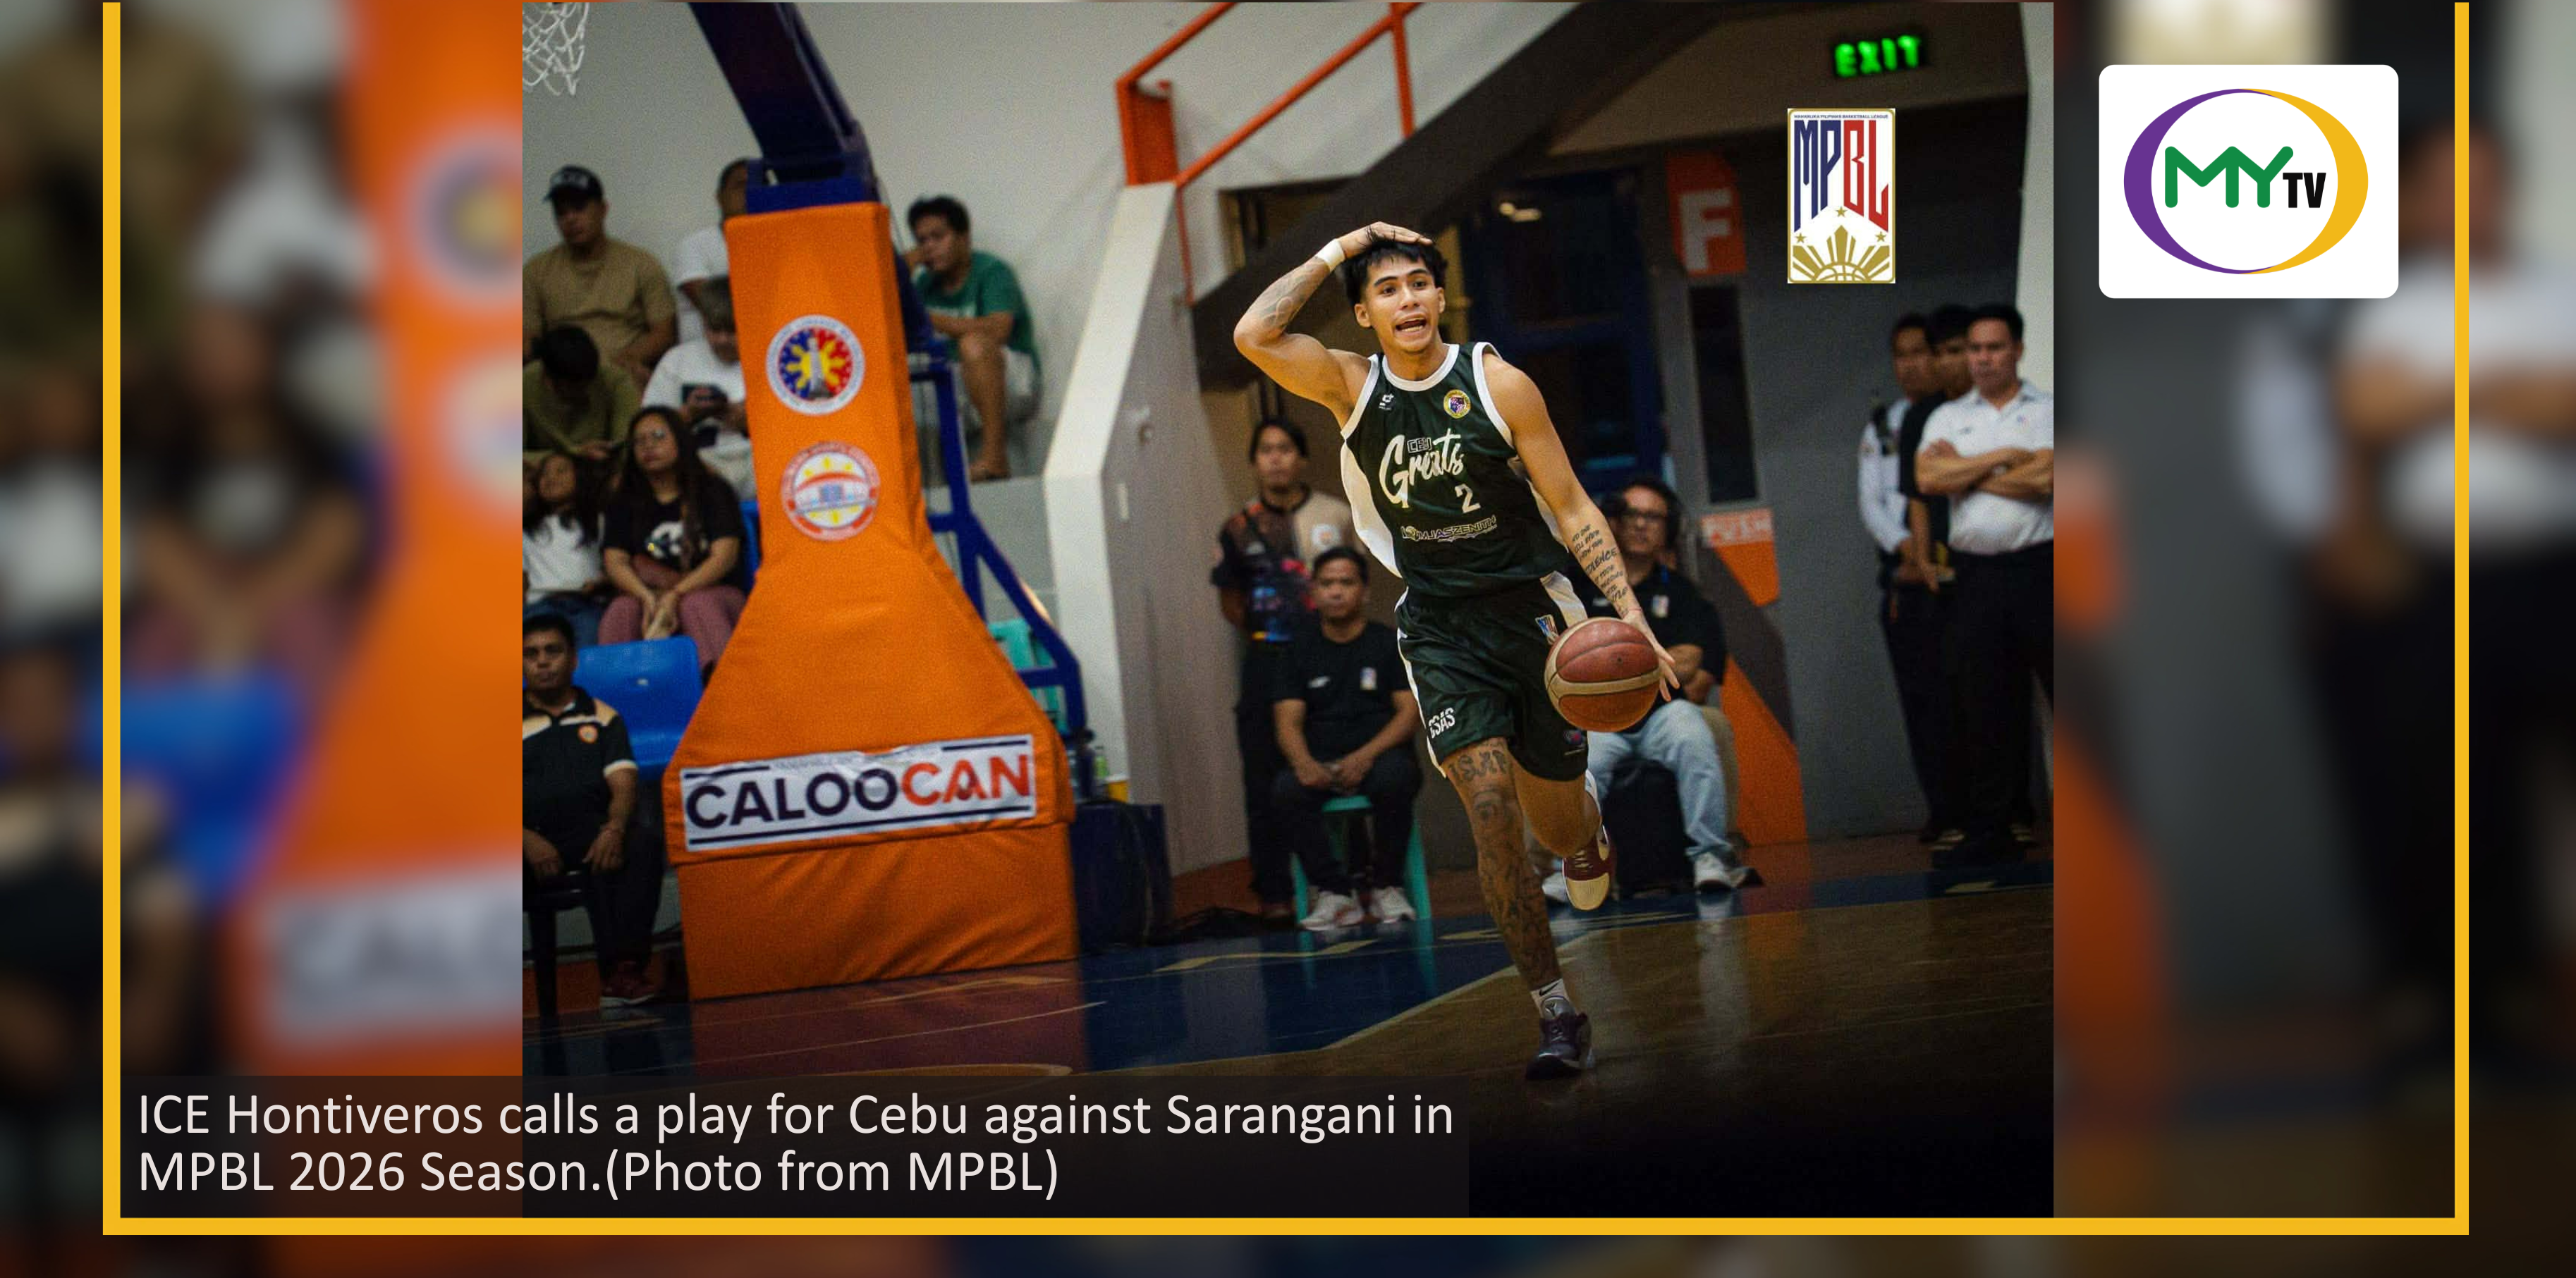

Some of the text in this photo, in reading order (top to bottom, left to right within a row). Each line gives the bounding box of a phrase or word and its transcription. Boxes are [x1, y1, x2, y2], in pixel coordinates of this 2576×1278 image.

[1835, 34, 1922, 78] EXIT
[1679, 188, 1731, 271] F
[1379, 428, 1465, 508] Greats
[1455, 483, 1481, 514] 2
[686, 754, 1030, 829] CALOOCAN
